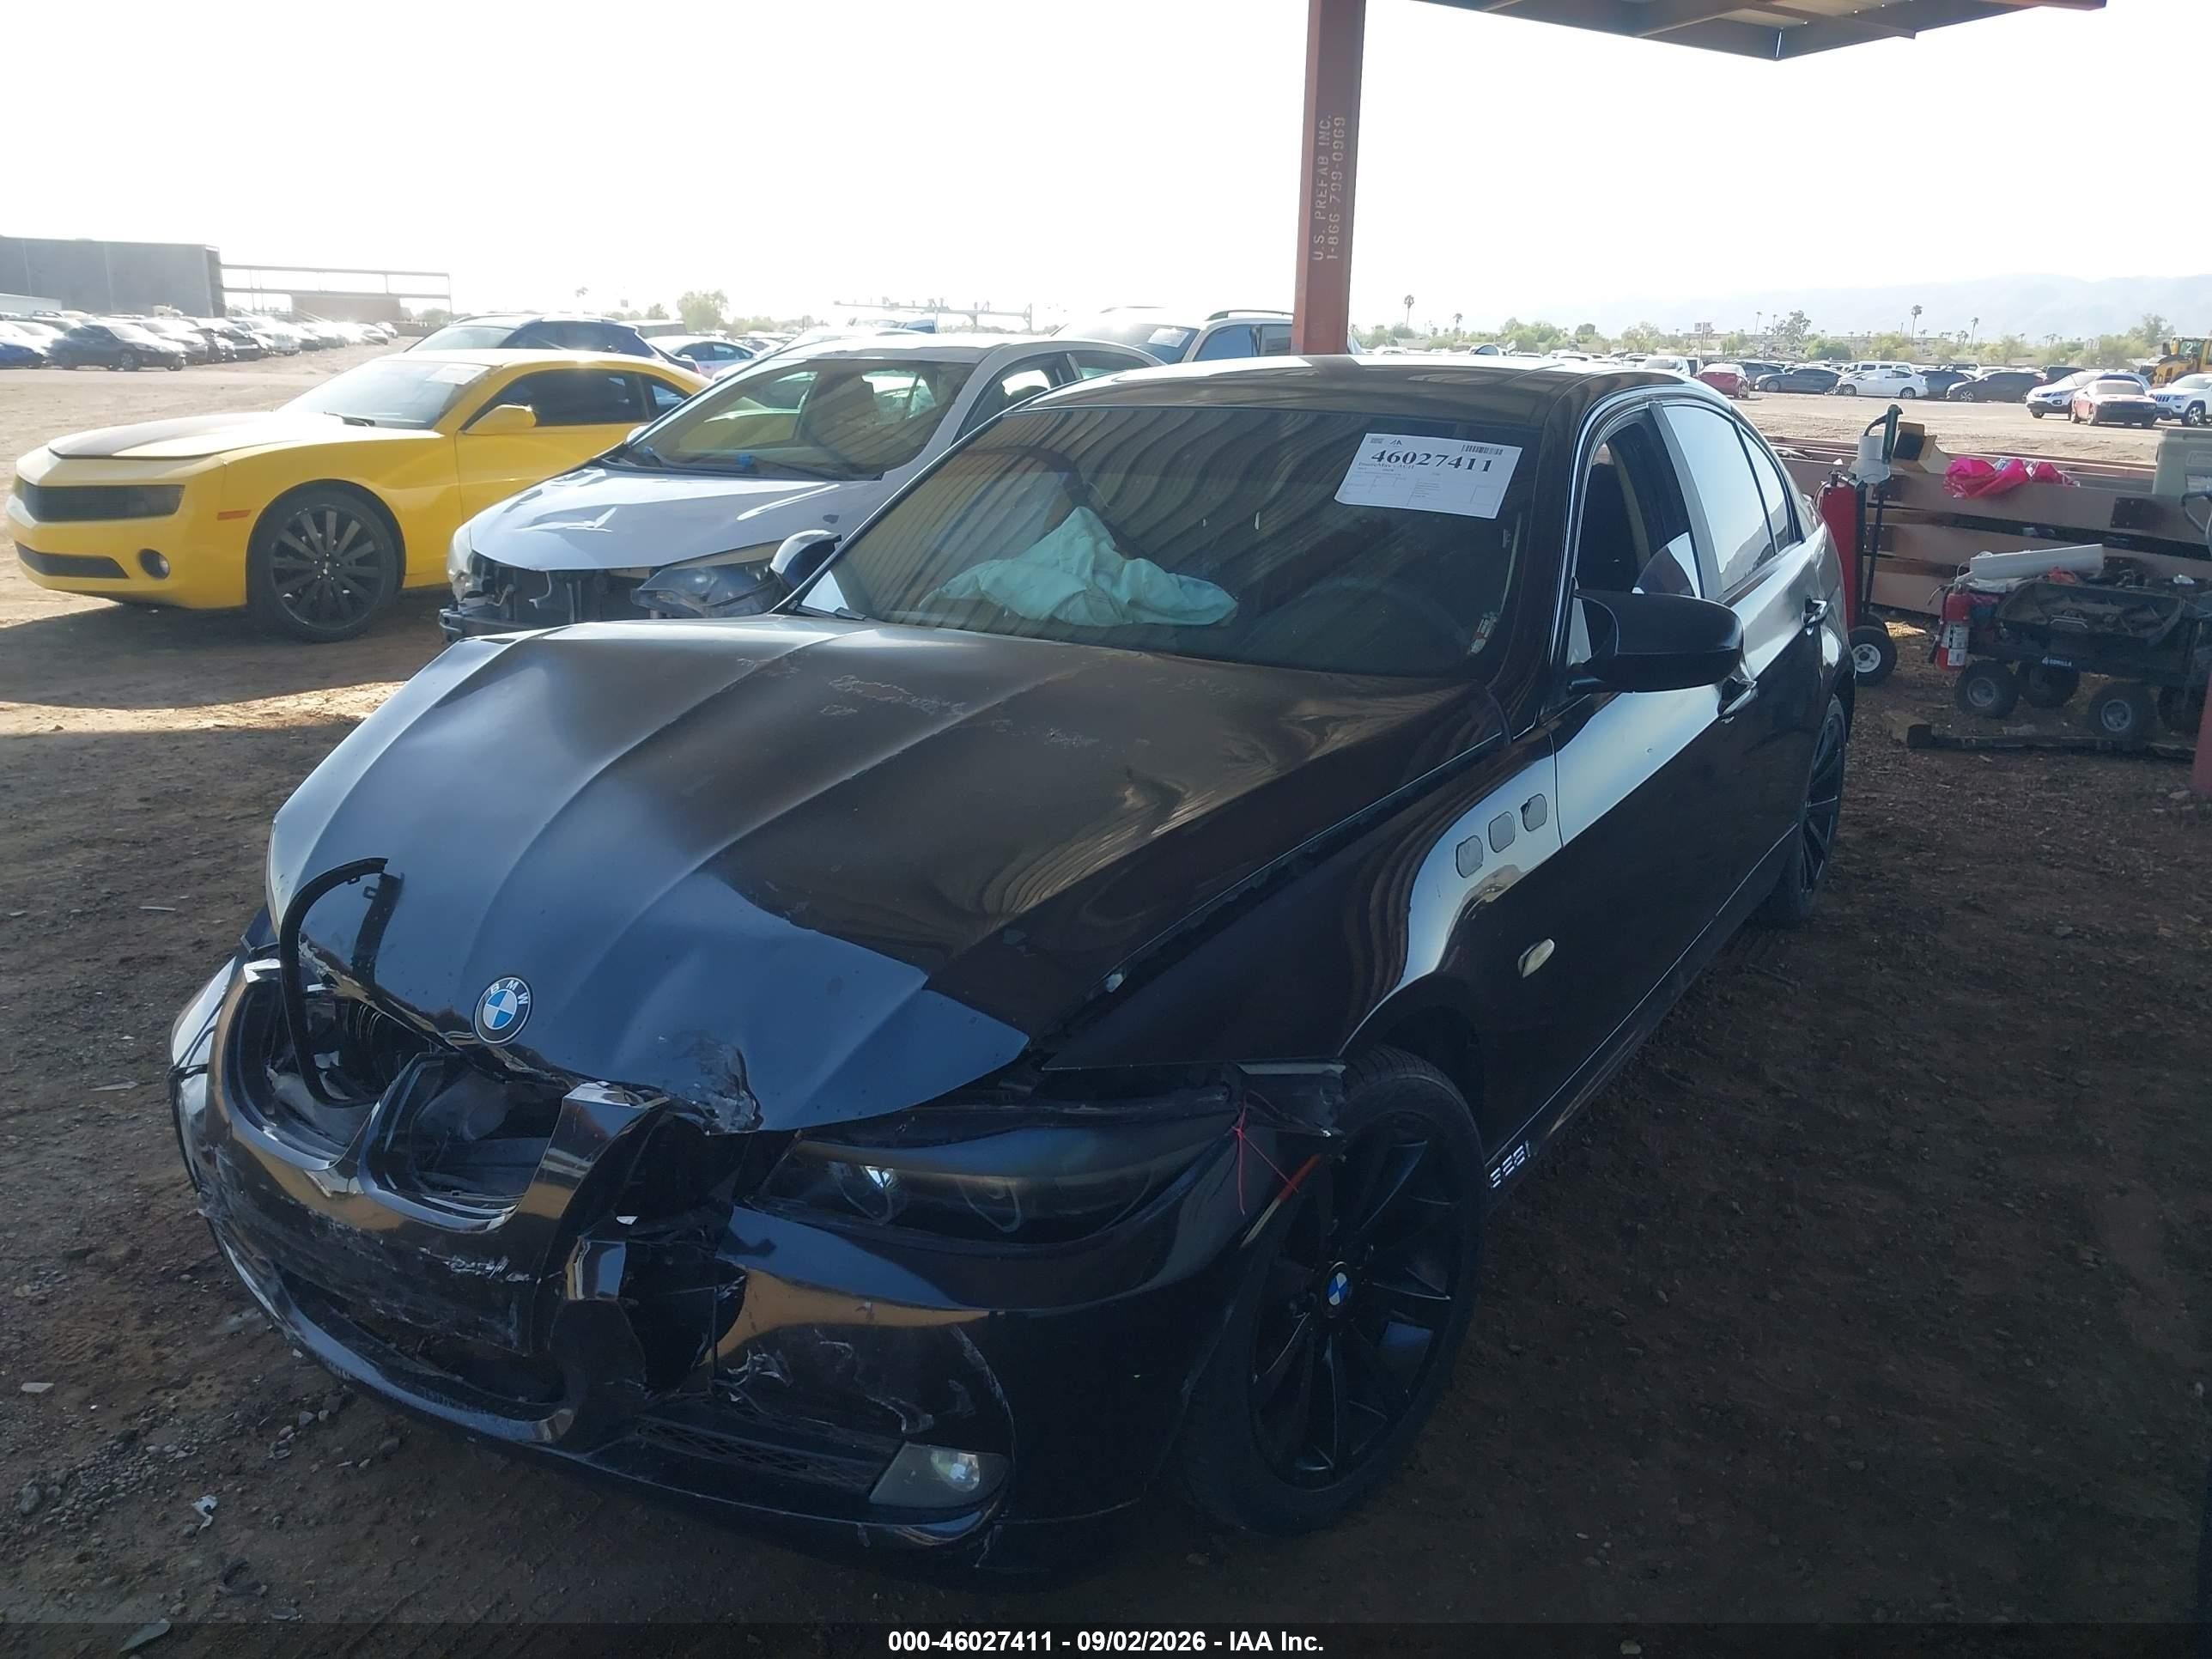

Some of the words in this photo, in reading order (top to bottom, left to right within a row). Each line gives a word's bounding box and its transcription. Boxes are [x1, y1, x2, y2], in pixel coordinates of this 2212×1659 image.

[1317, 114, 1332, 147] INC.
[1315, 155, 1329, 220] PREFAB
[1312, 229, 1326, 261] U.S.
[1371, 449, 1493, 472] 46027411
[490, 980, 528, 1005] BMW
